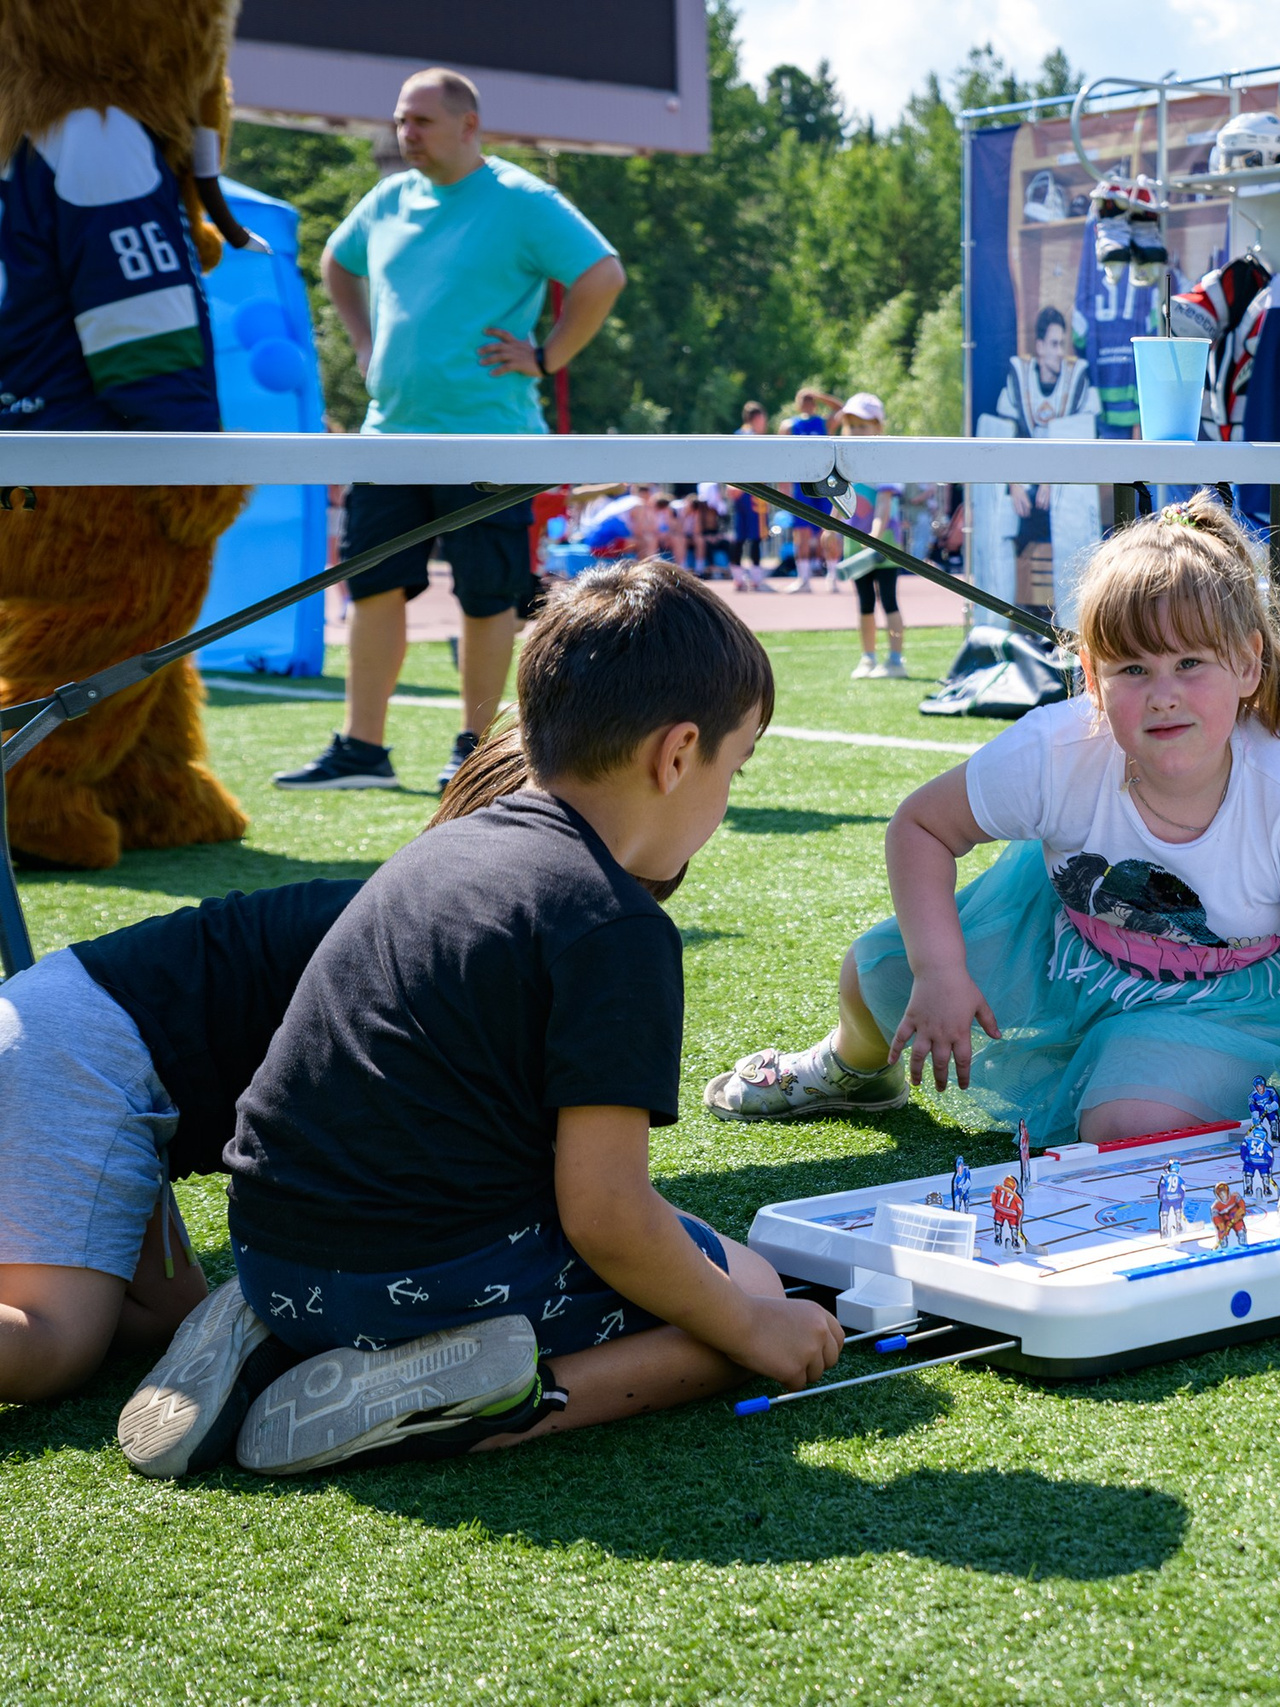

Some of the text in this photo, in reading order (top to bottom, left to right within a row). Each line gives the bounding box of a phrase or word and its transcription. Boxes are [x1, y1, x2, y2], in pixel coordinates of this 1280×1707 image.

[109, 220, 181, 281] 86
[1250, 1139, 1265, 1157] 54
[1167, 1175, 1179, 1193] 19
[1000, 1189, 1015, 1208] 17
